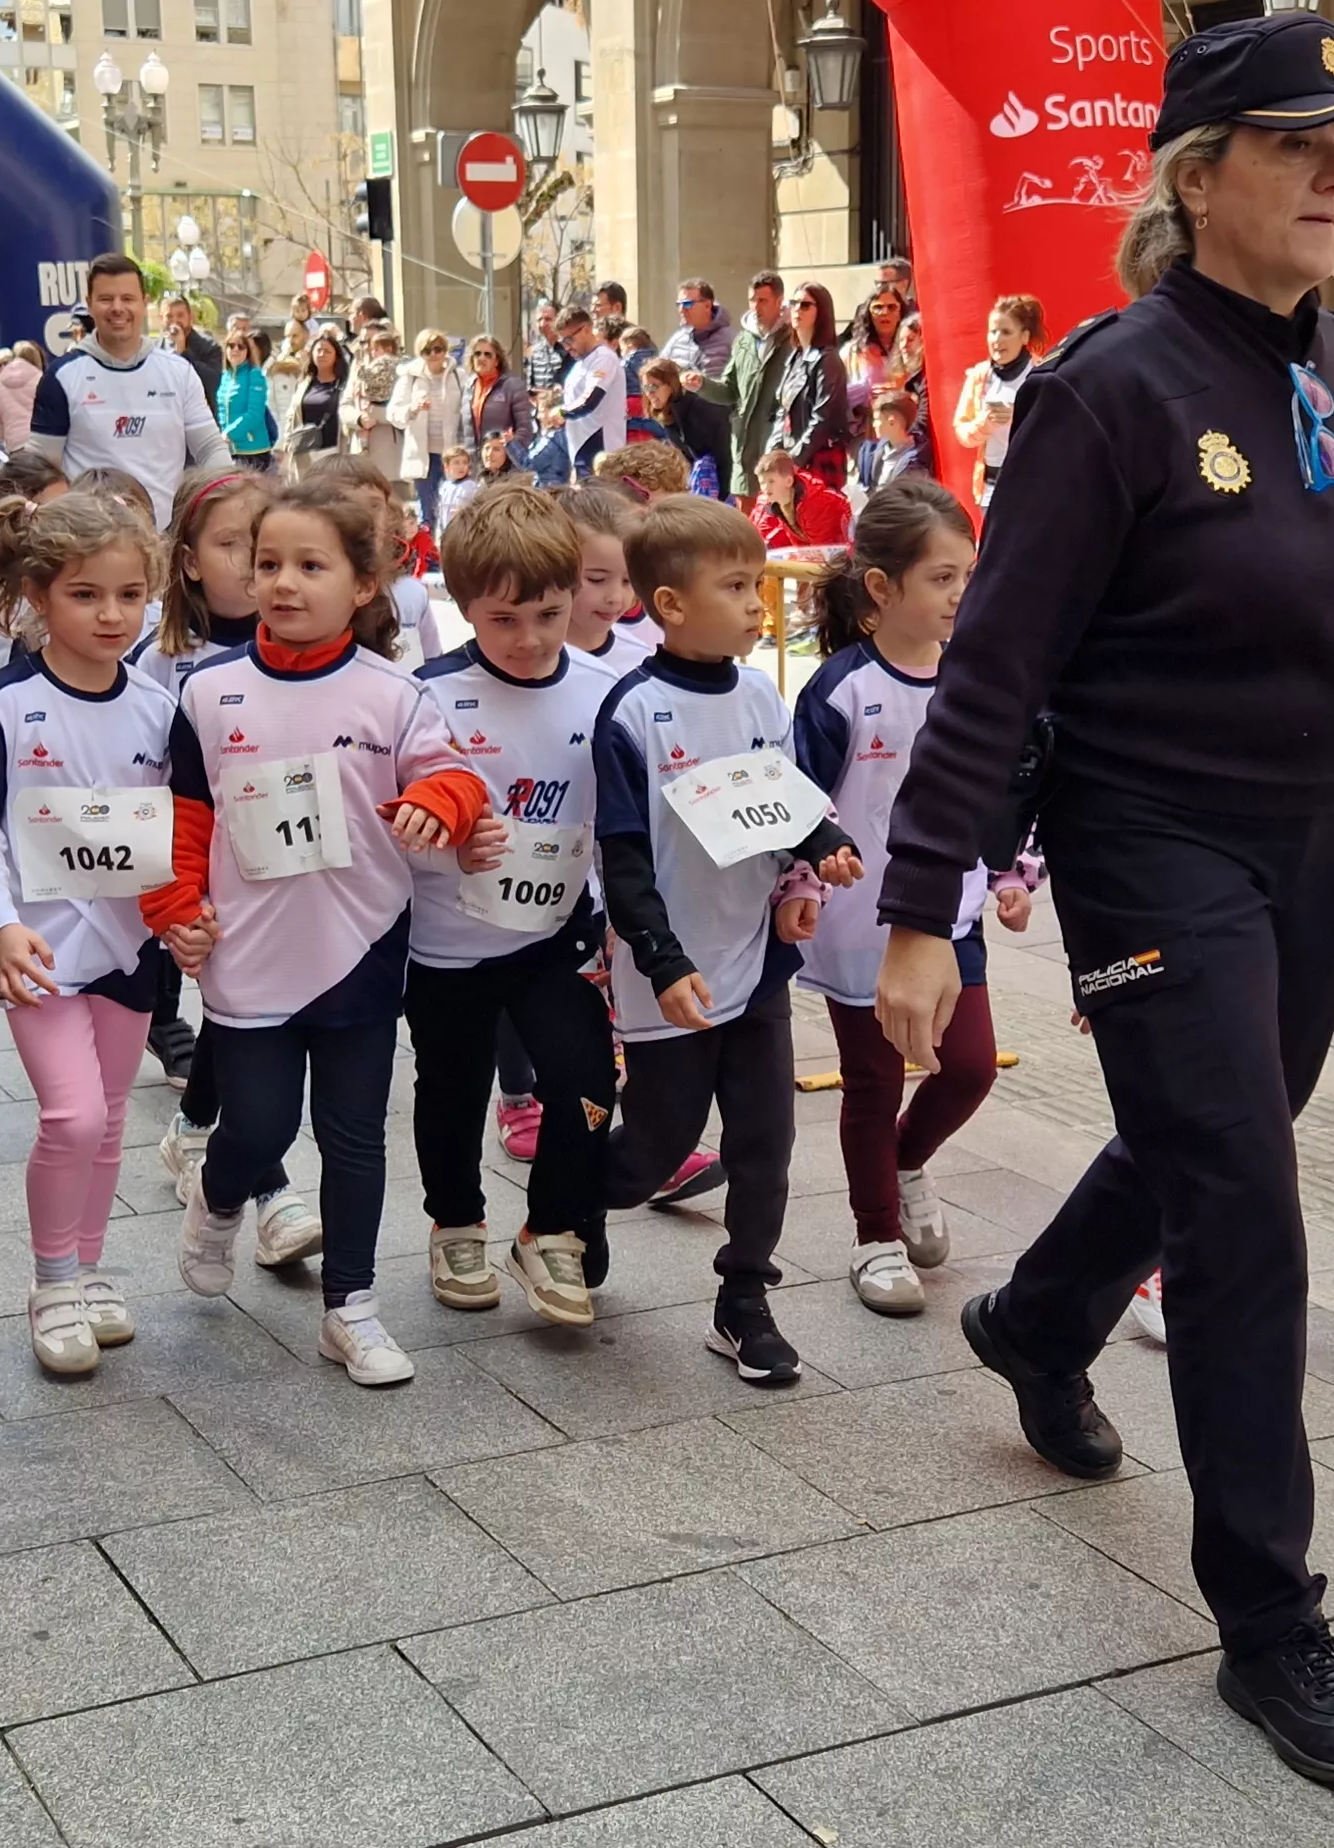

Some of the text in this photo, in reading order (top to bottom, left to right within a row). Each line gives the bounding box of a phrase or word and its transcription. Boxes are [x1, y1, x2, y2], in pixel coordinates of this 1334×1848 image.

[1049, 26, 1153, 71] Sports
[1044, 92, 1160, 131] Santan
[38, 261, 90, 306] RUT
[358, 739, 391, 756] mupol
[18, 758, 64, 768] Santander
[658, 757, 701, 773] Santander
[731, 801, 791, 829] 1050
[275, 814, 321, 846] 11
[59, 846, 134, 871] 1042
[498, 877, 565, 906] 1009
[1080, 963, 1164, 997] NACIONAL
